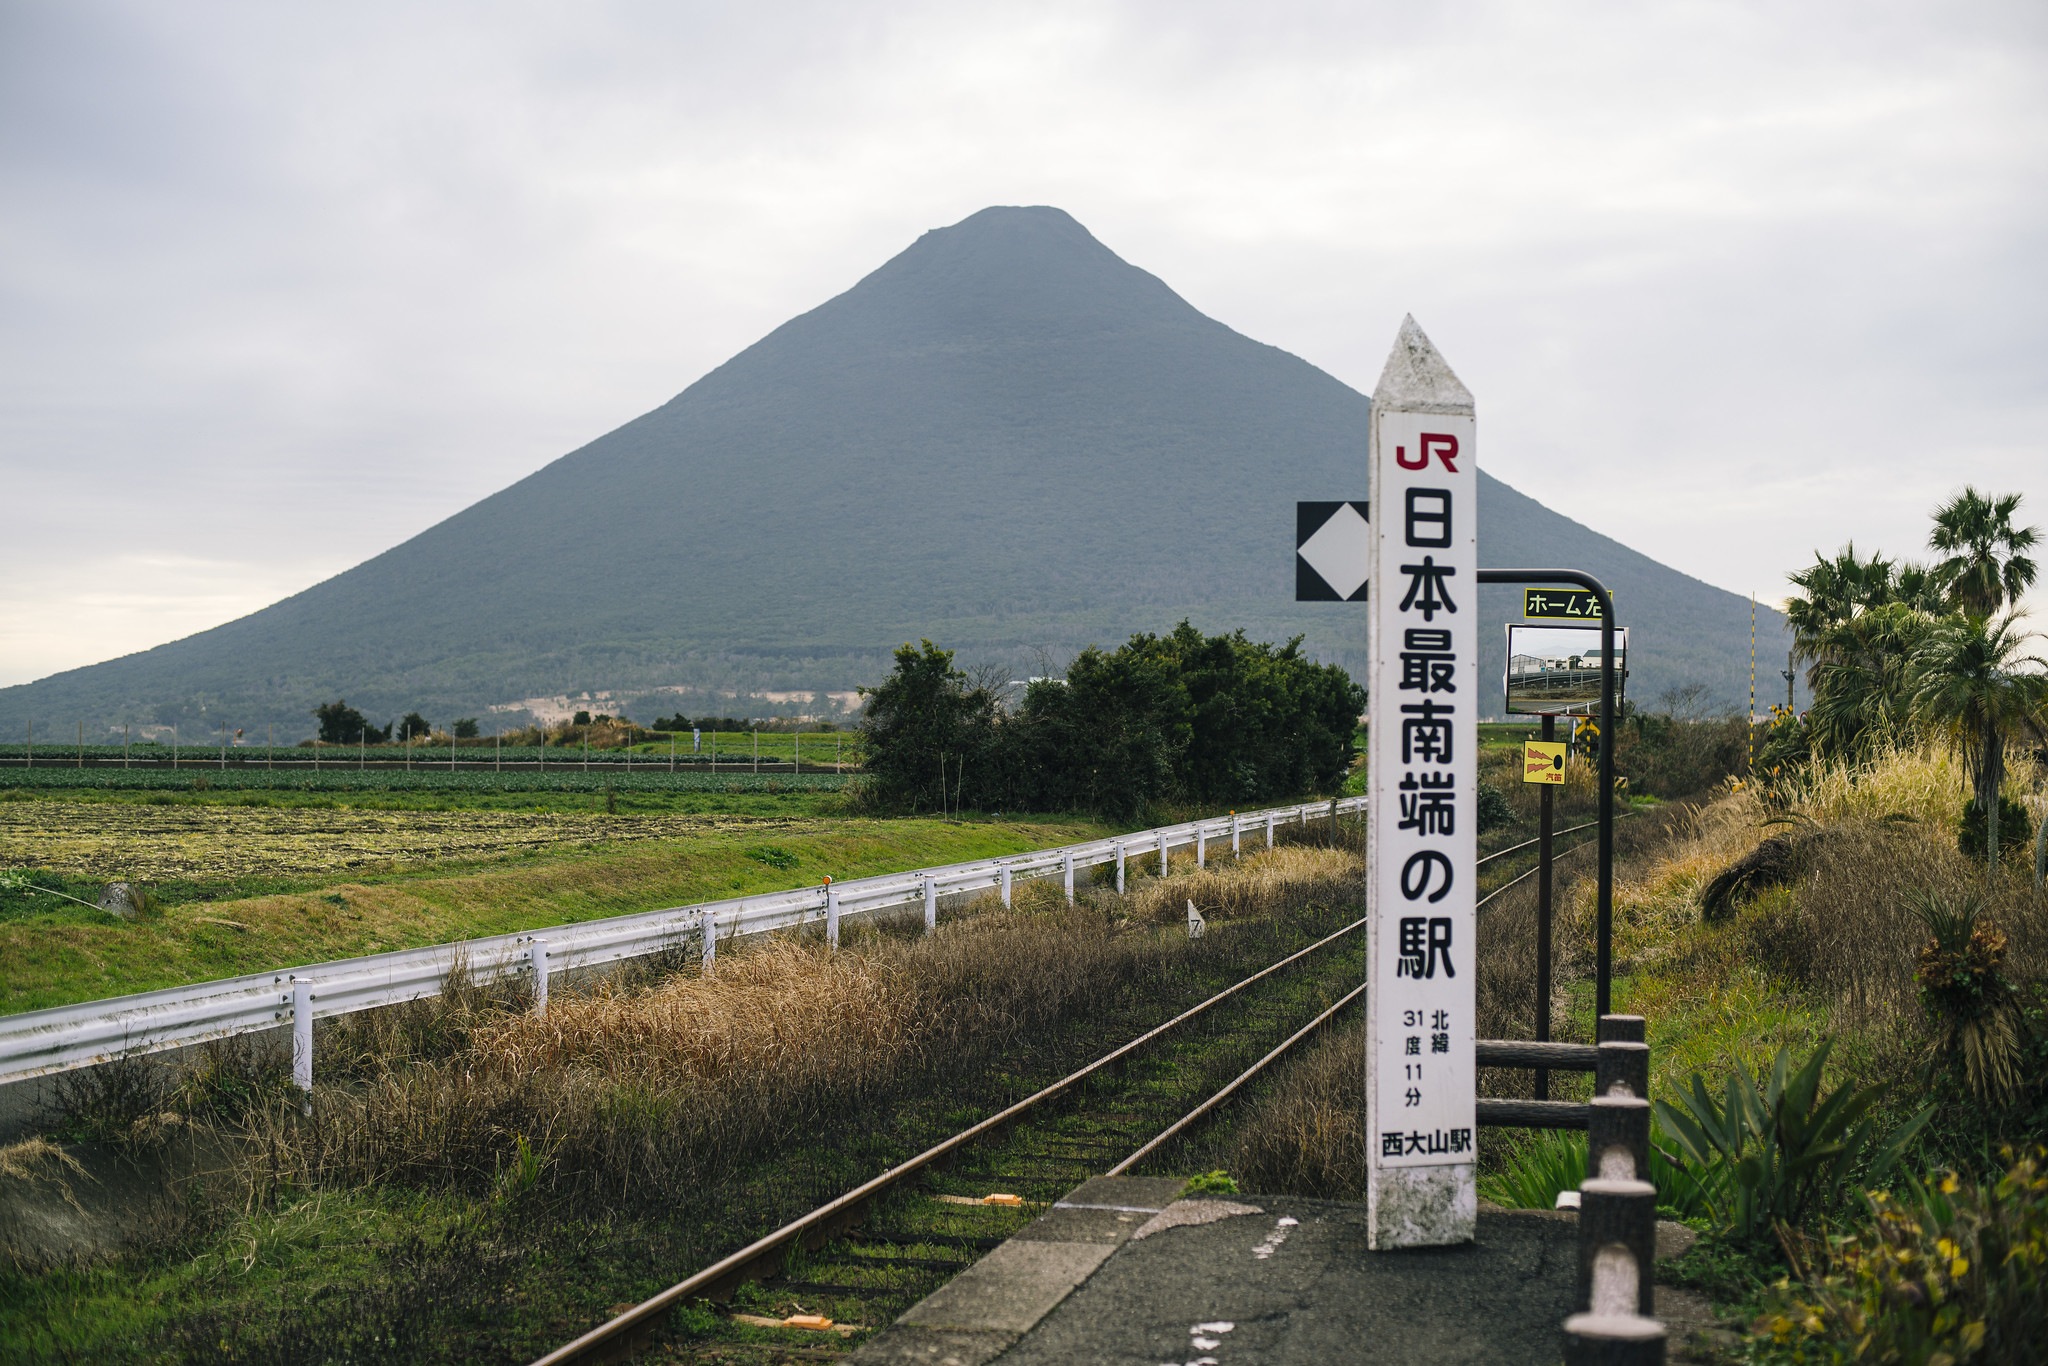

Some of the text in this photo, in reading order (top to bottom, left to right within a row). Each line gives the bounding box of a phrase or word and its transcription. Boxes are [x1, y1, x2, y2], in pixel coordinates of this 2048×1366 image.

[1396, 433, 1459, 473] JR
[1397, 487, 1457, 979] 日本最南端の駅
[1431, 1009, 1449, 1054] 北緯
[1382, 1128, 1471, 1157] 西大山駅
